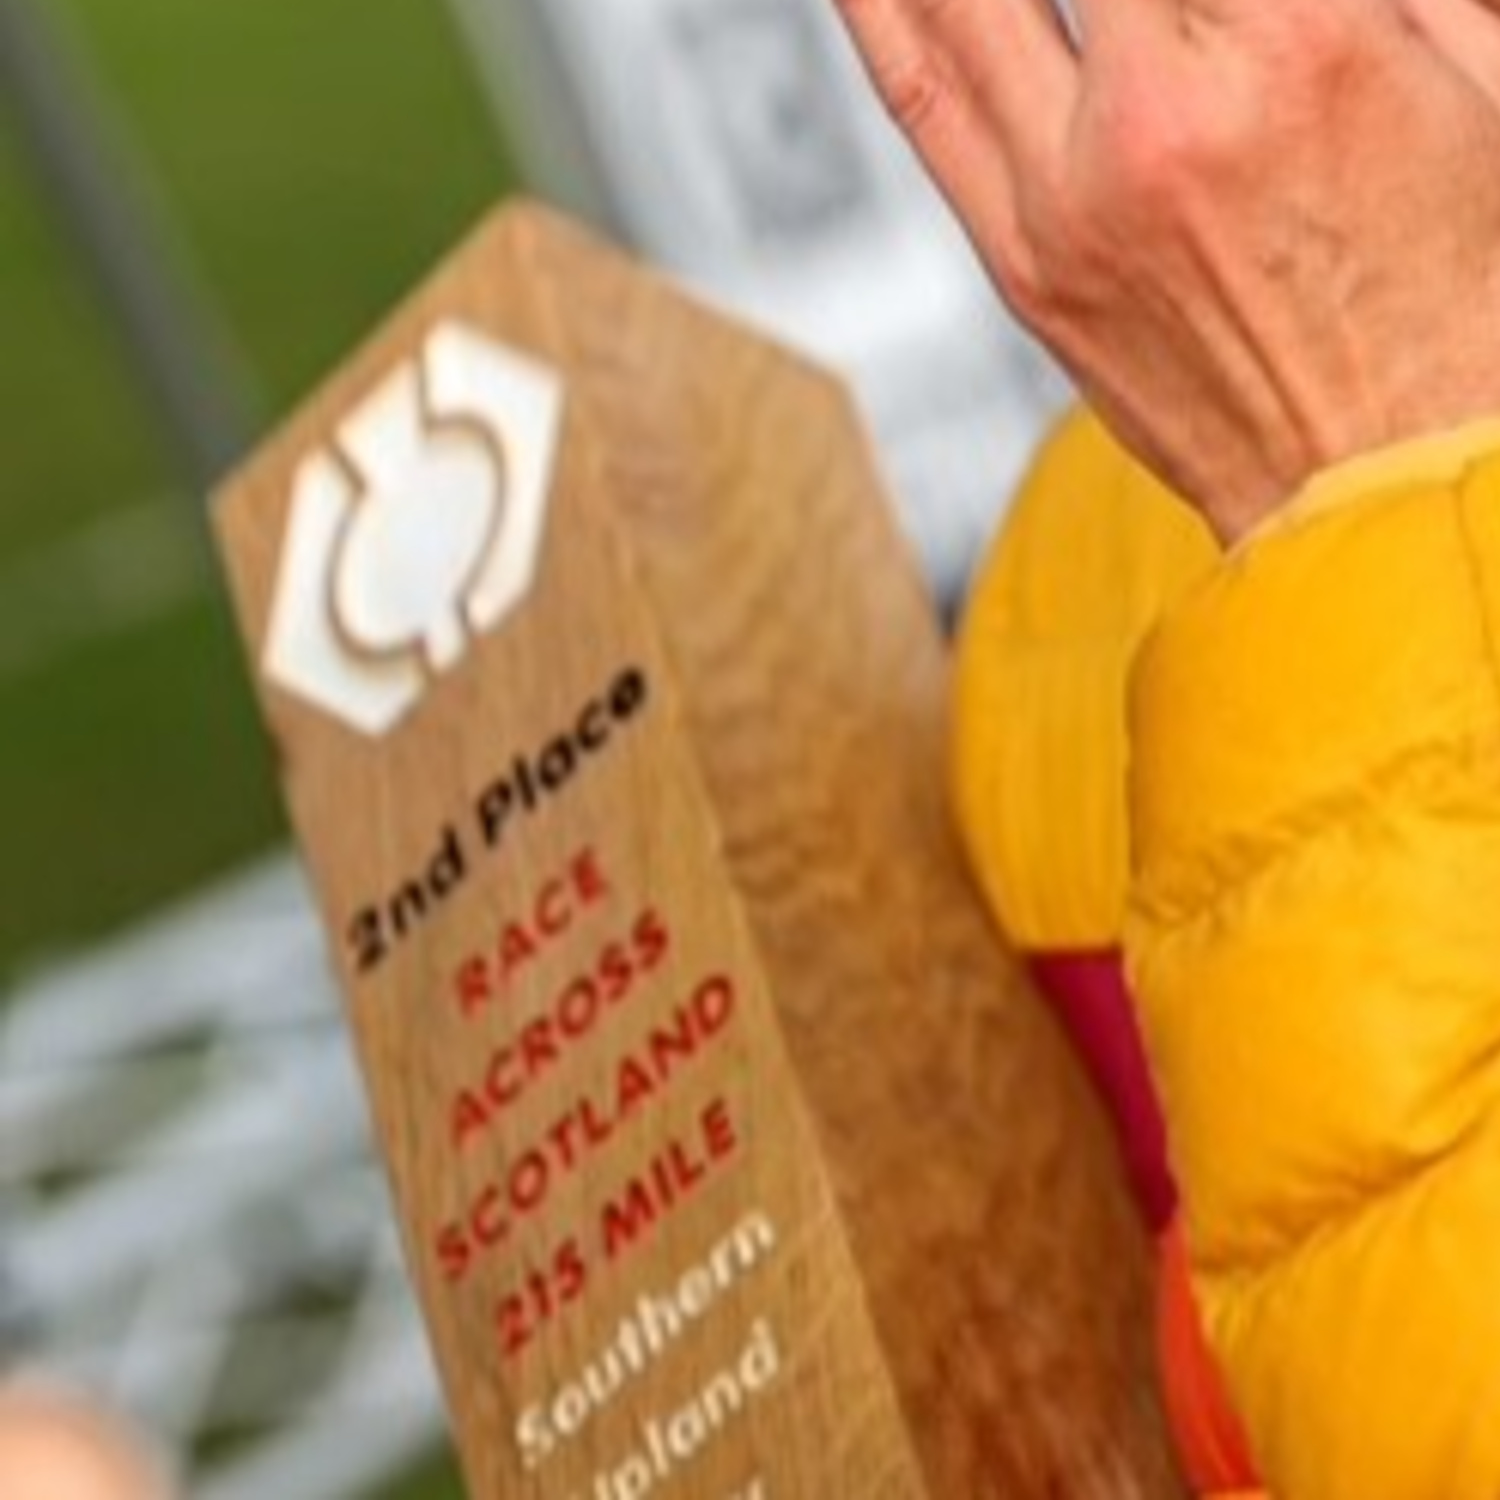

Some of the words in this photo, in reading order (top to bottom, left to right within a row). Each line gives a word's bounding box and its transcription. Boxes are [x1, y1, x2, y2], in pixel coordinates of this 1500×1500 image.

[347, 825, 465, 974] 2nd
[475, 667, 646, 845] Place
[455, 846, 609, 1014] RACE
[435, 973, 736, 1279] SCOTLAND
[449, 909, 670, 1148] ACROSS
[497, 1238, 586, 1358] 215
[601, 1099, 738, 1261] MILE
[514, 1208, 774, 1468] Southern
